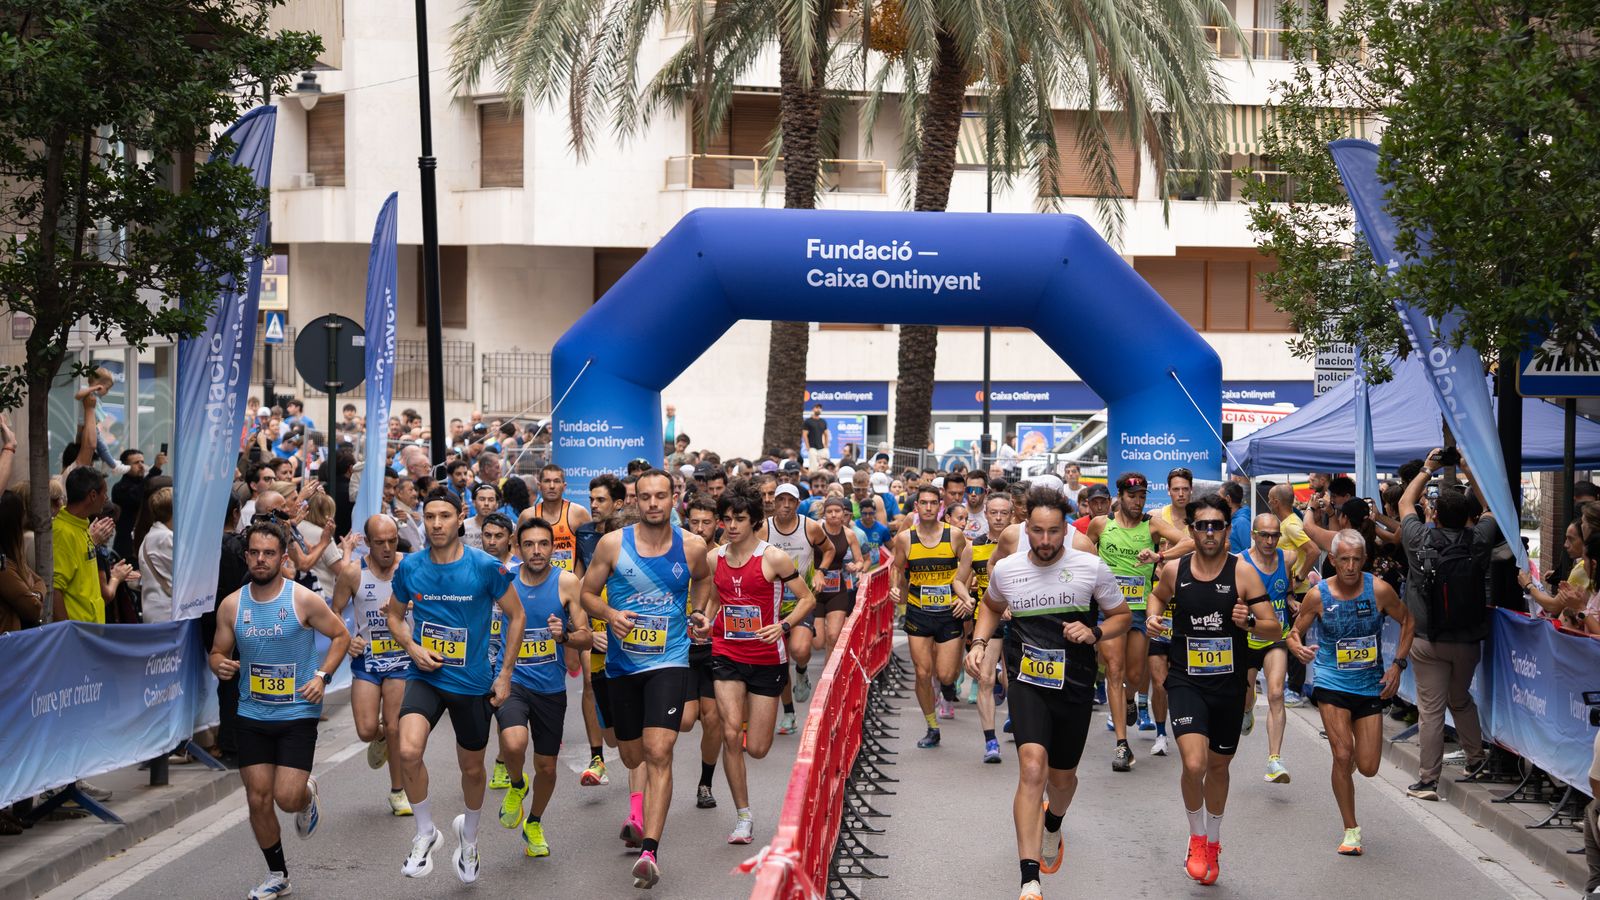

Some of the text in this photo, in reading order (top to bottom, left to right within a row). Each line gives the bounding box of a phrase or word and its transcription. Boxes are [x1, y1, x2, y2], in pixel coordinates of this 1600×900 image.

[806, 238, 913, 261] Fundació
[806, 267, 981, 294] Caixa Ontinyent
[1318, 356, 1355, 366] nacion
[810, 391, 873, 403] Caixa Ontinyent
[990, 391, 1050, 402] Caixa Ontinyent
[1241, 390, 1275, 400] Ontinyent
[1222, 413, 1282, 424] CIAS VA
[559, 419, 609, 432] Fundació
[560, 435, 644, 449] Caixa Ontinyent
[1121, 432, 1176, 445] Fundació
[1121, 448, 1209, 463] Caixa Ontinyent
[1120, 586, 1138, 595] 116
[441, 594, 473, 602] Ontinyent
[927, 595, 945, 603] 109
[1012, 591, 1075, 610] triatlón ibi
[245, 623, 283, 637] stock
[733, 618, 753, 629] 151
[632, 628, 657, 642] 103
[431, 639, 456, 654] 113
[523, 641, 547, 654] 118
[1197, 651, 1222, 663] 101
[1345, 648, 1369, 660] 129
[1028, 661, 1054, 675] 106
[259, 678, 285, 691] 138
